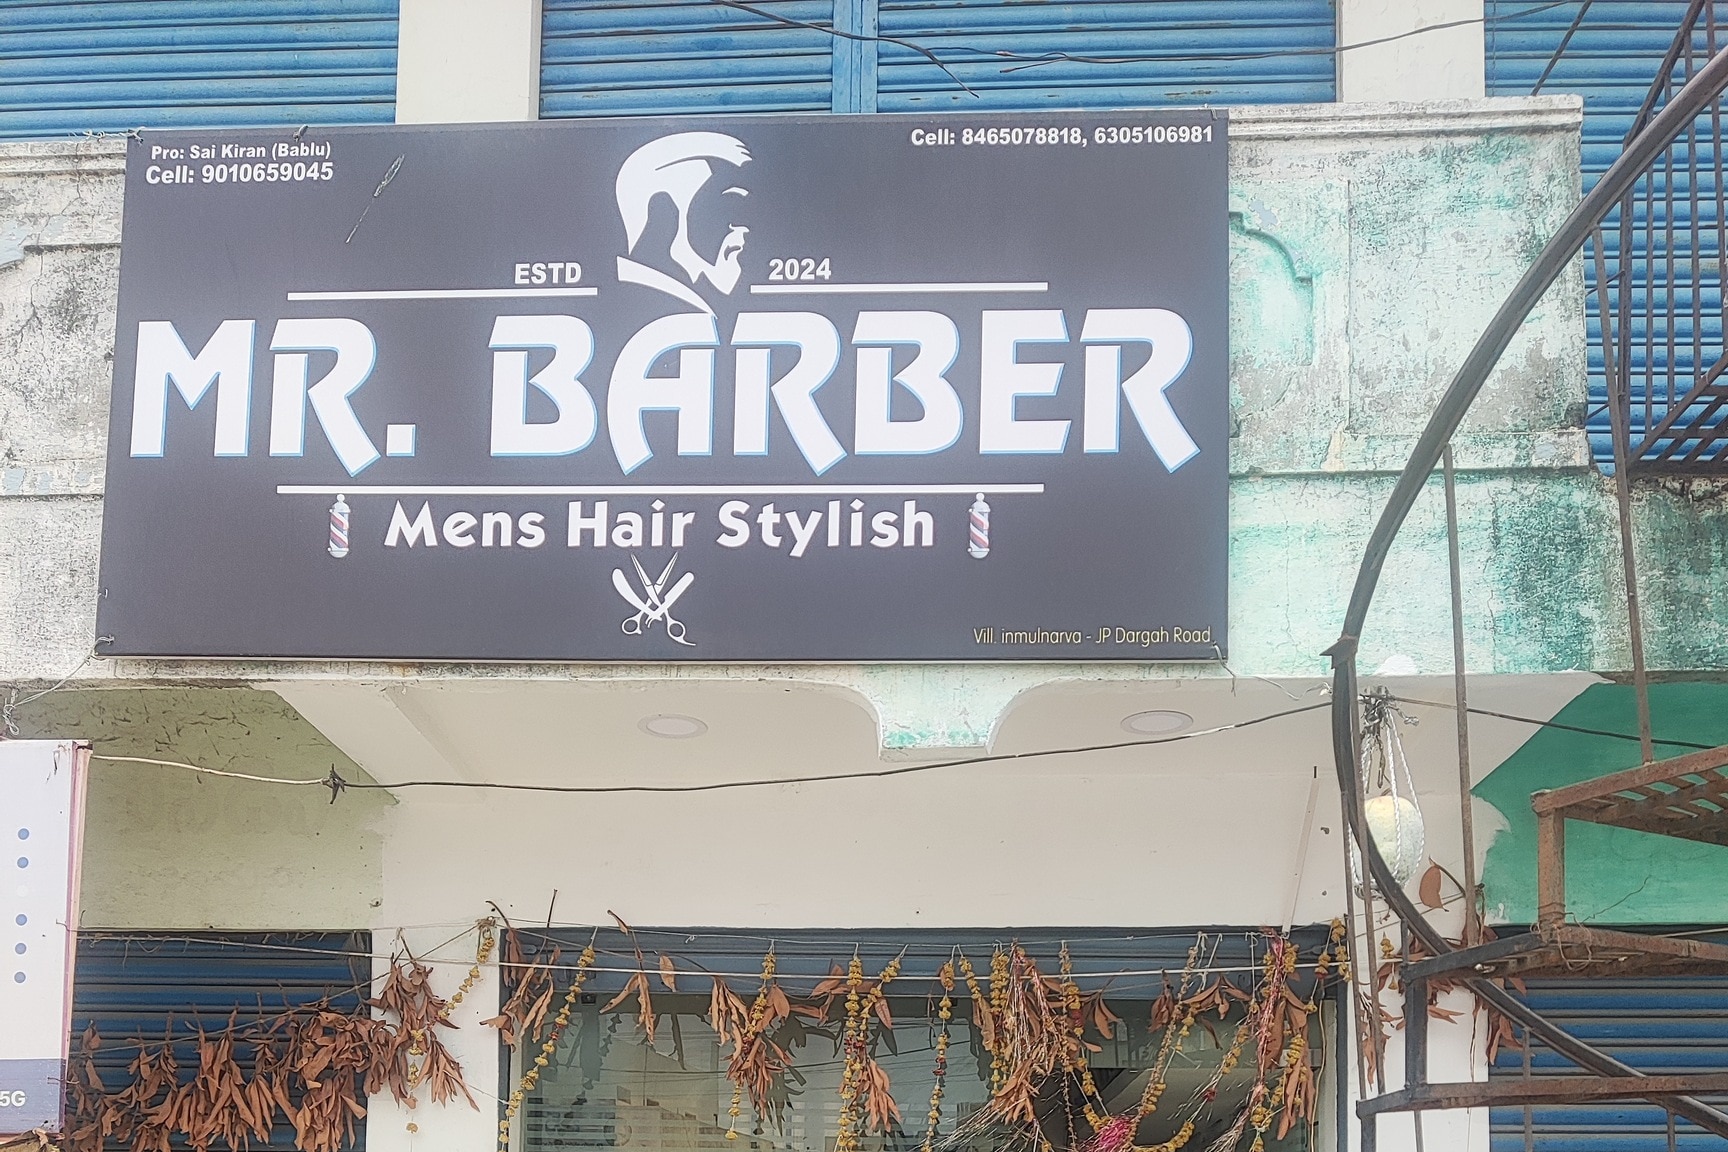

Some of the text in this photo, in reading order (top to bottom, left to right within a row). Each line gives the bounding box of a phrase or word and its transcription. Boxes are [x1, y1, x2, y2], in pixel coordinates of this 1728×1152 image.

[911, 125, 1213, 148] Cell: 8465078818, 6305106981
[150, 141, 331, 160] Pro: Sai Kiran (Bablu)
[145, 161, 334, 184] Cell: 9010659045
[514, 262, 582, 284] ESTD
[768, 257, 832, 281] 2024
[129, 308, 1201, 478] MR. BARBER
[383, 499, 934, 558] Mens Hair Stylish
[973, 627, 997, 644] Vill.
[1001, 627, 1082, 644] inmulnarva
[1095, 627, 1112, 645] JP
[1115, 626, 1170, 648] Dargah
